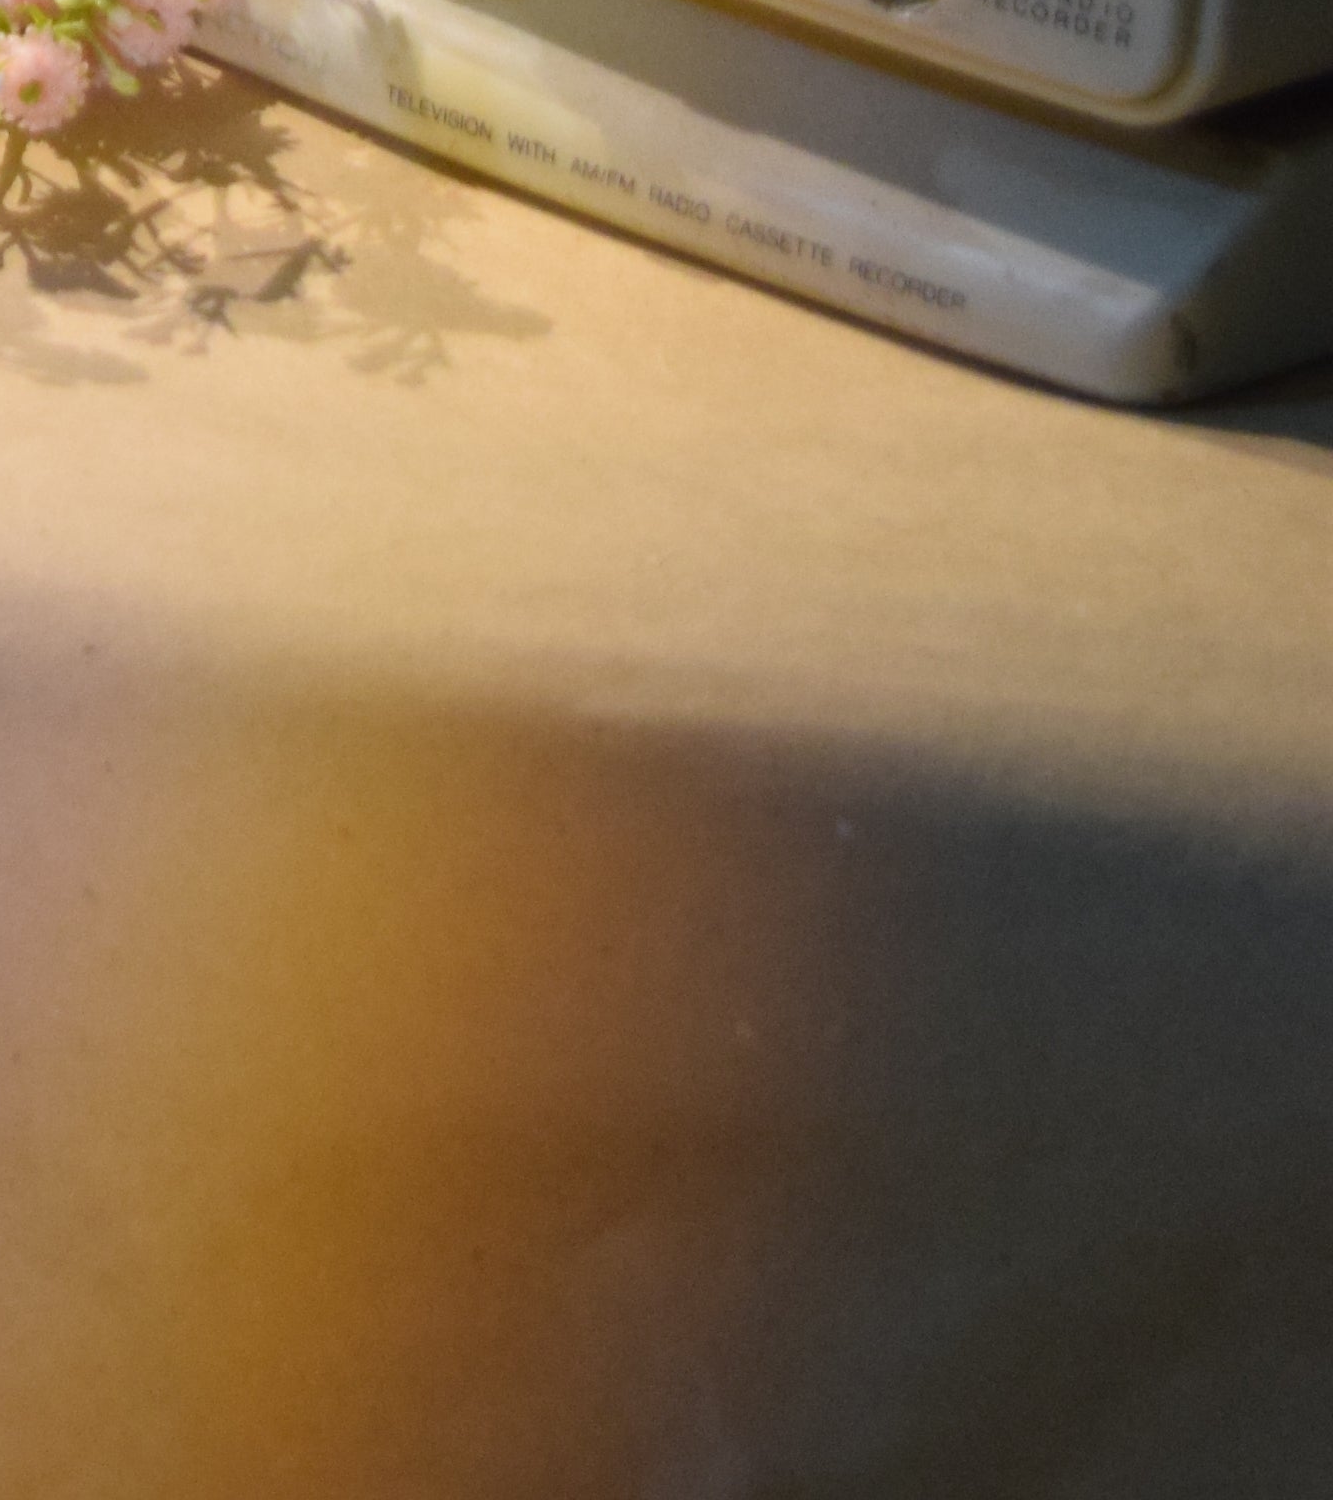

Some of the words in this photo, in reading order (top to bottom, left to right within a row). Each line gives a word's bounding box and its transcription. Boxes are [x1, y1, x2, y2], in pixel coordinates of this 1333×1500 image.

[387, 83, 493, 142] TELEVISION
[507, 128, 557, 165] WITH
[570, 156, 636, 195] AM/FM
[650, 184, 712, 223] RADIO
[725, 211, 834, 268] CASSETTE
[848, 255, 968, 312] RECORDER
